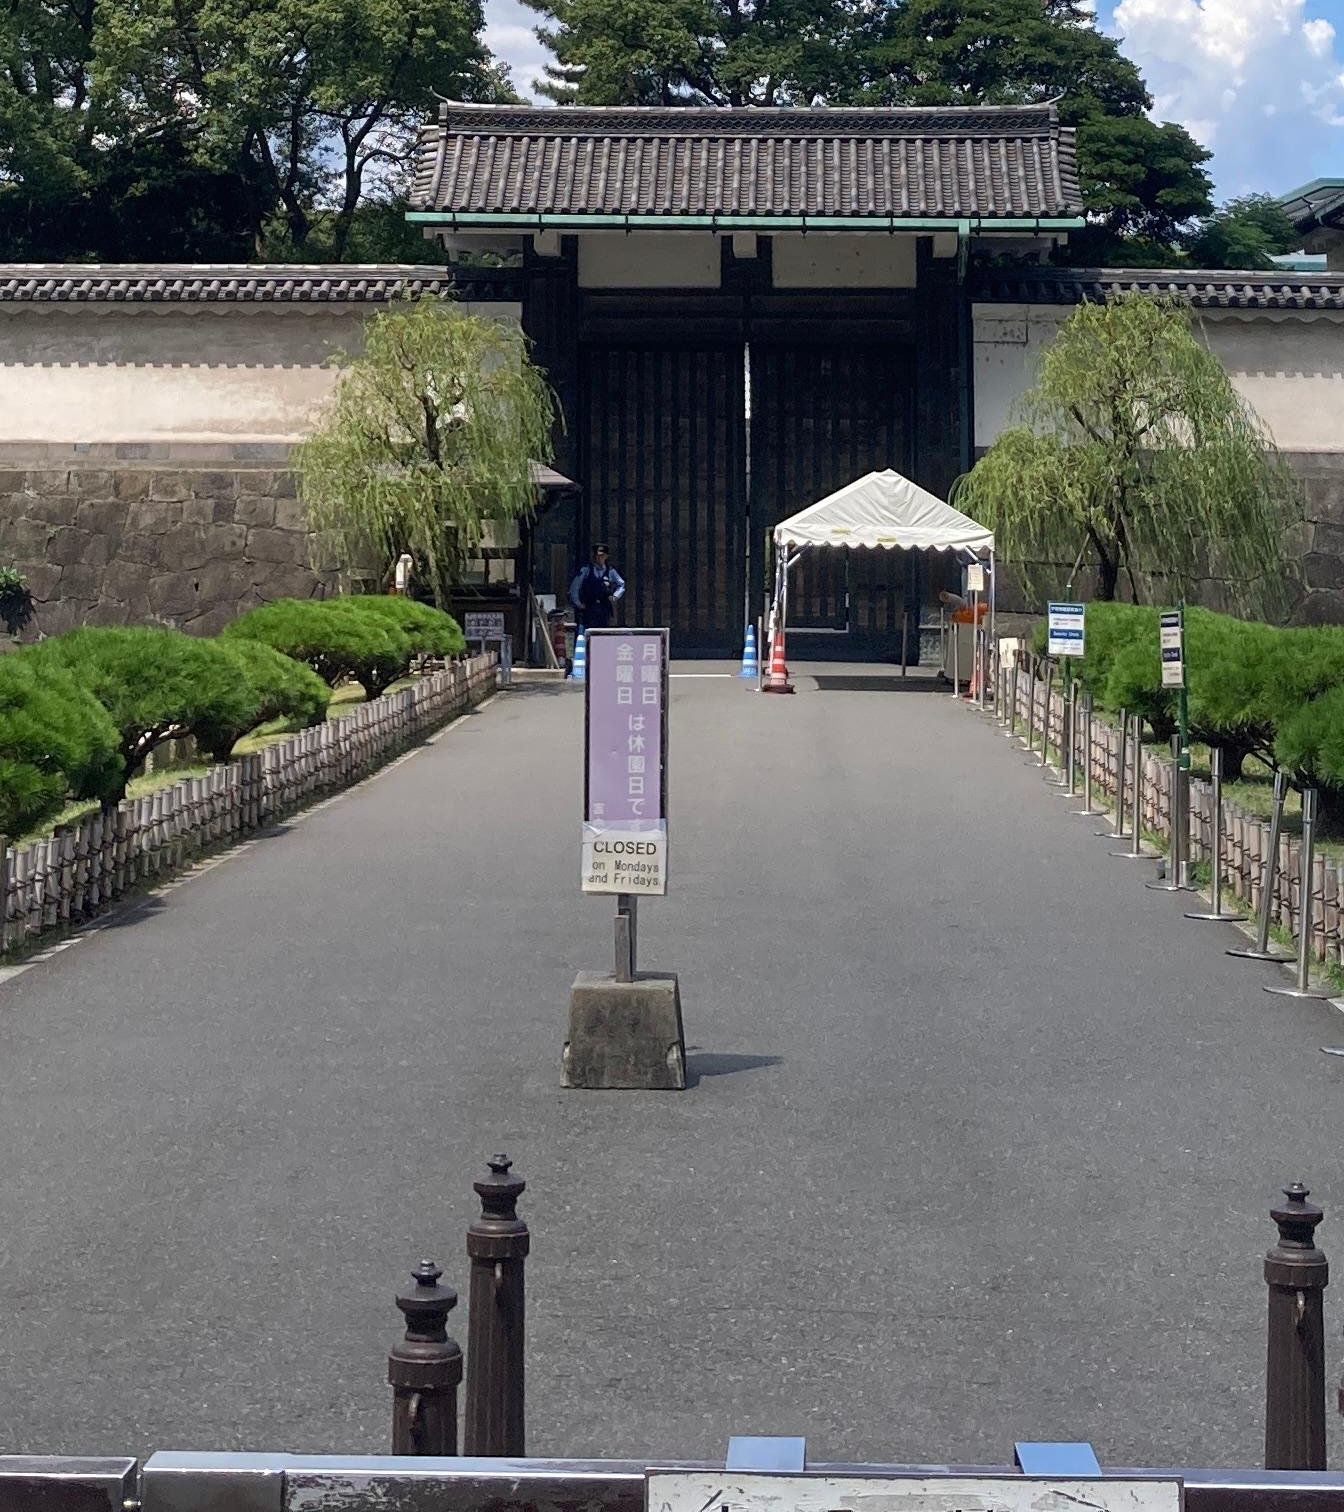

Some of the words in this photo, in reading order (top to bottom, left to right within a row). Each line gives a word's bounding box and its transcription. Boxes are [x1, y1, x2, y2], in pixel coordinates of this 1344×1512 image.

[616, 643, 634, 705] 金曜日
[641, 643, 659, 705] 月曜日
[593, 840, 657, 856] CLOSED
[592, 861, 605, 870] on
[614, 859, 659, 874] Mondays
[588, 873, 608, 884] and
[613, 872, 659, 887] Fridays
